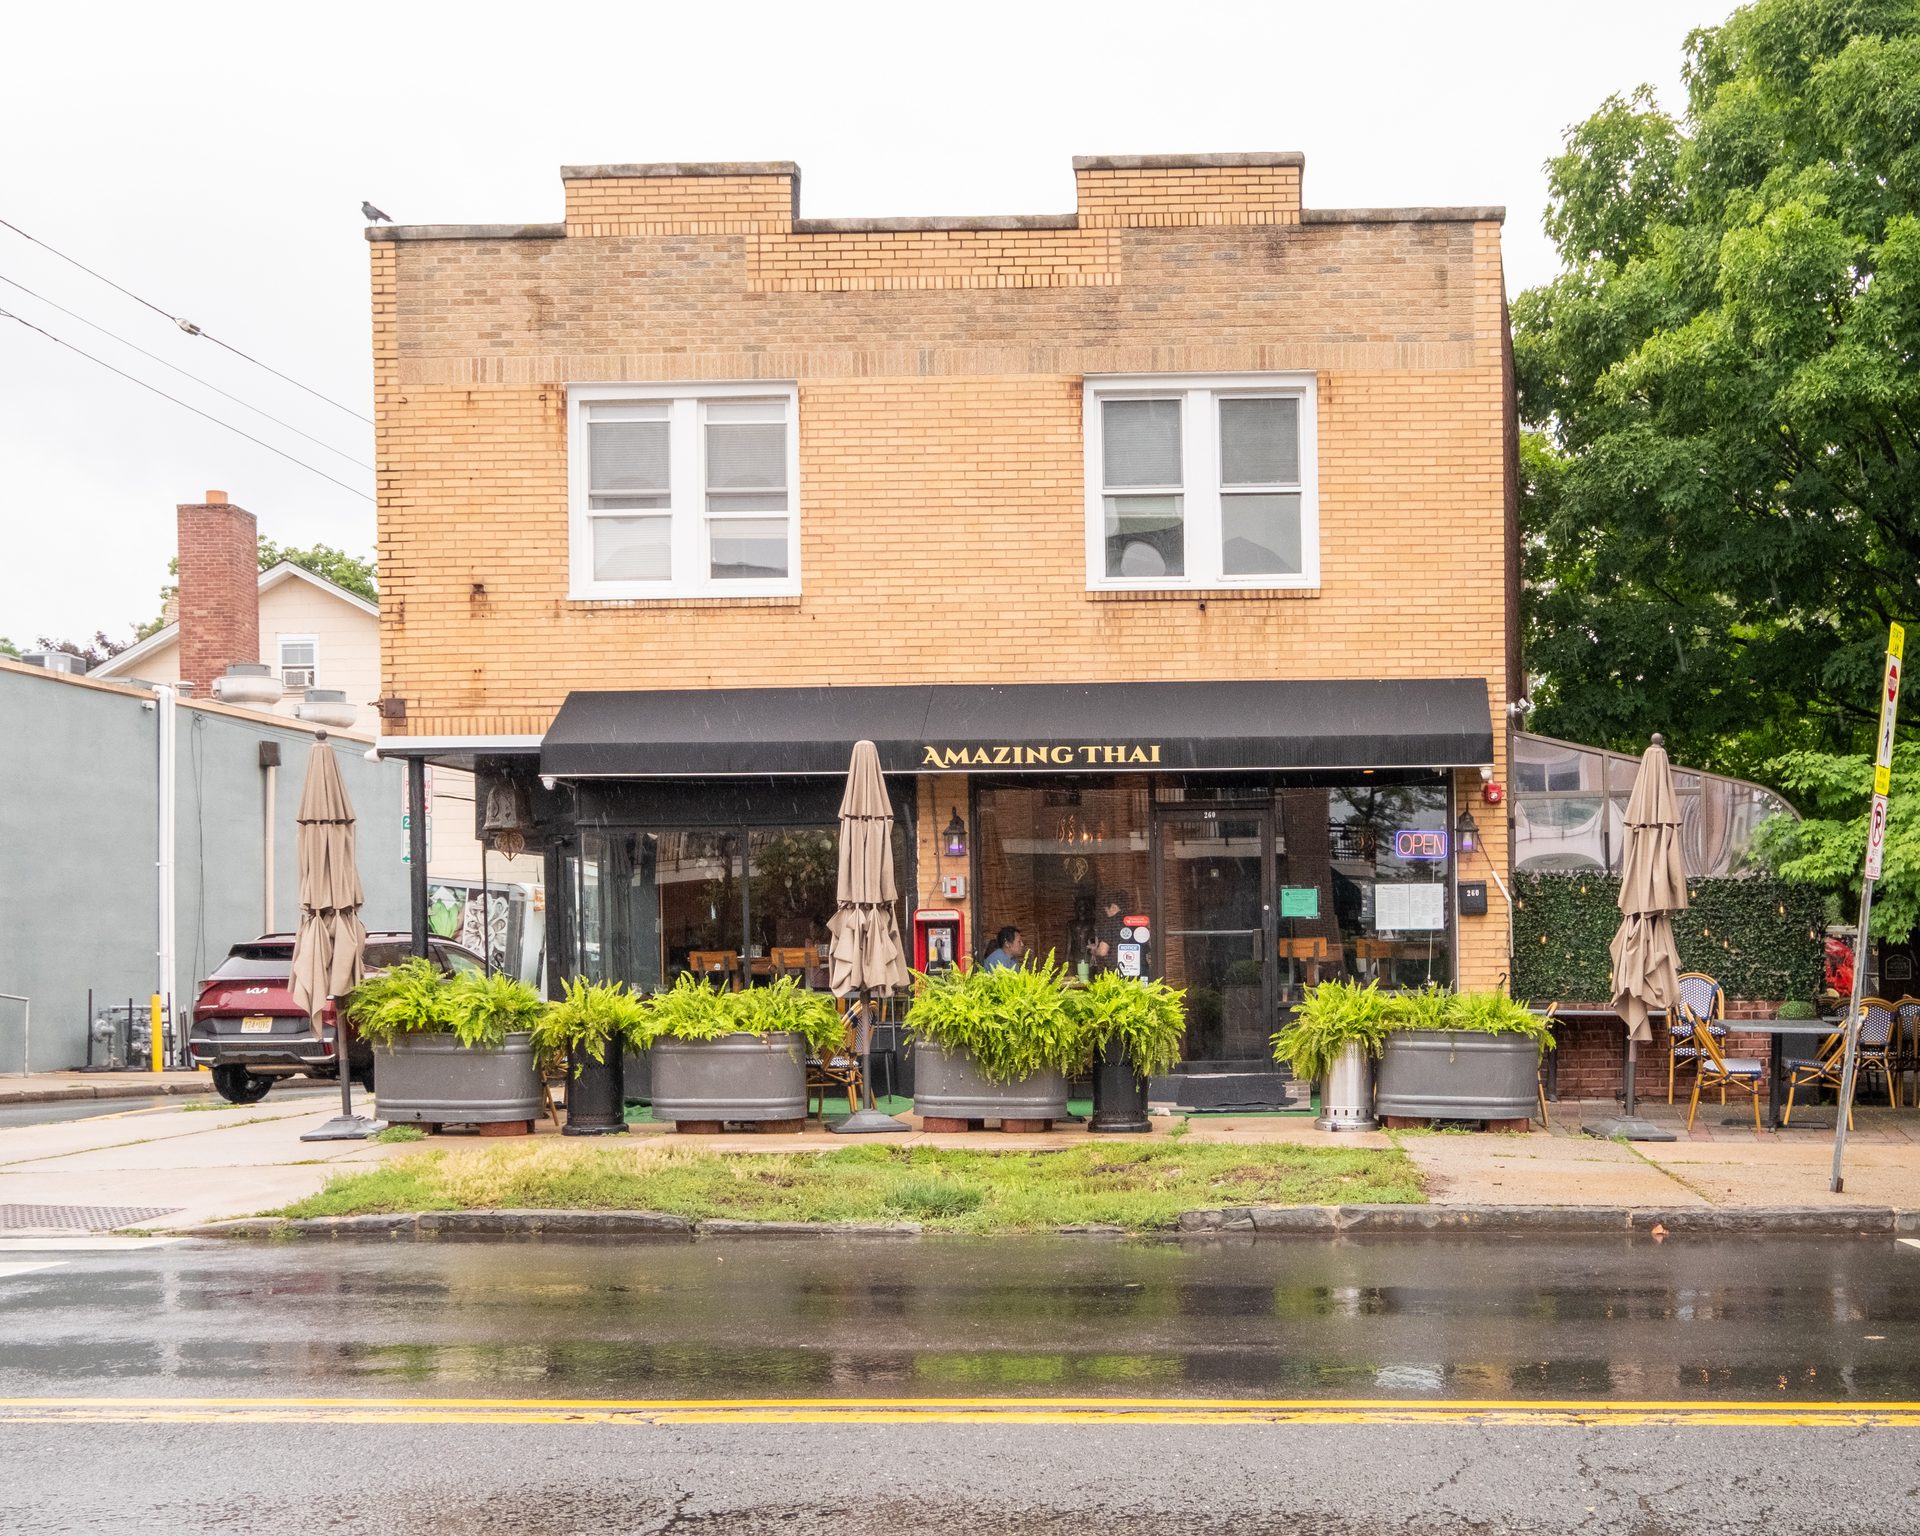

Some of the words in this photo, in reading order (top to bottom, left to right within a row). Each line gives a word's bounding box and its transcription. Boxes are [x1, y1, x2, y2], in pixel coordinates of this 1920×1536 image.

[922, 745, 1075, 769] AMAZING
[1078, 745, 1161, 763] THAI
[1203, 811, 1216, 819] 260
[1398, 833, 1445, 855] OPEN
[1466, 889, 1480, 897] 260
